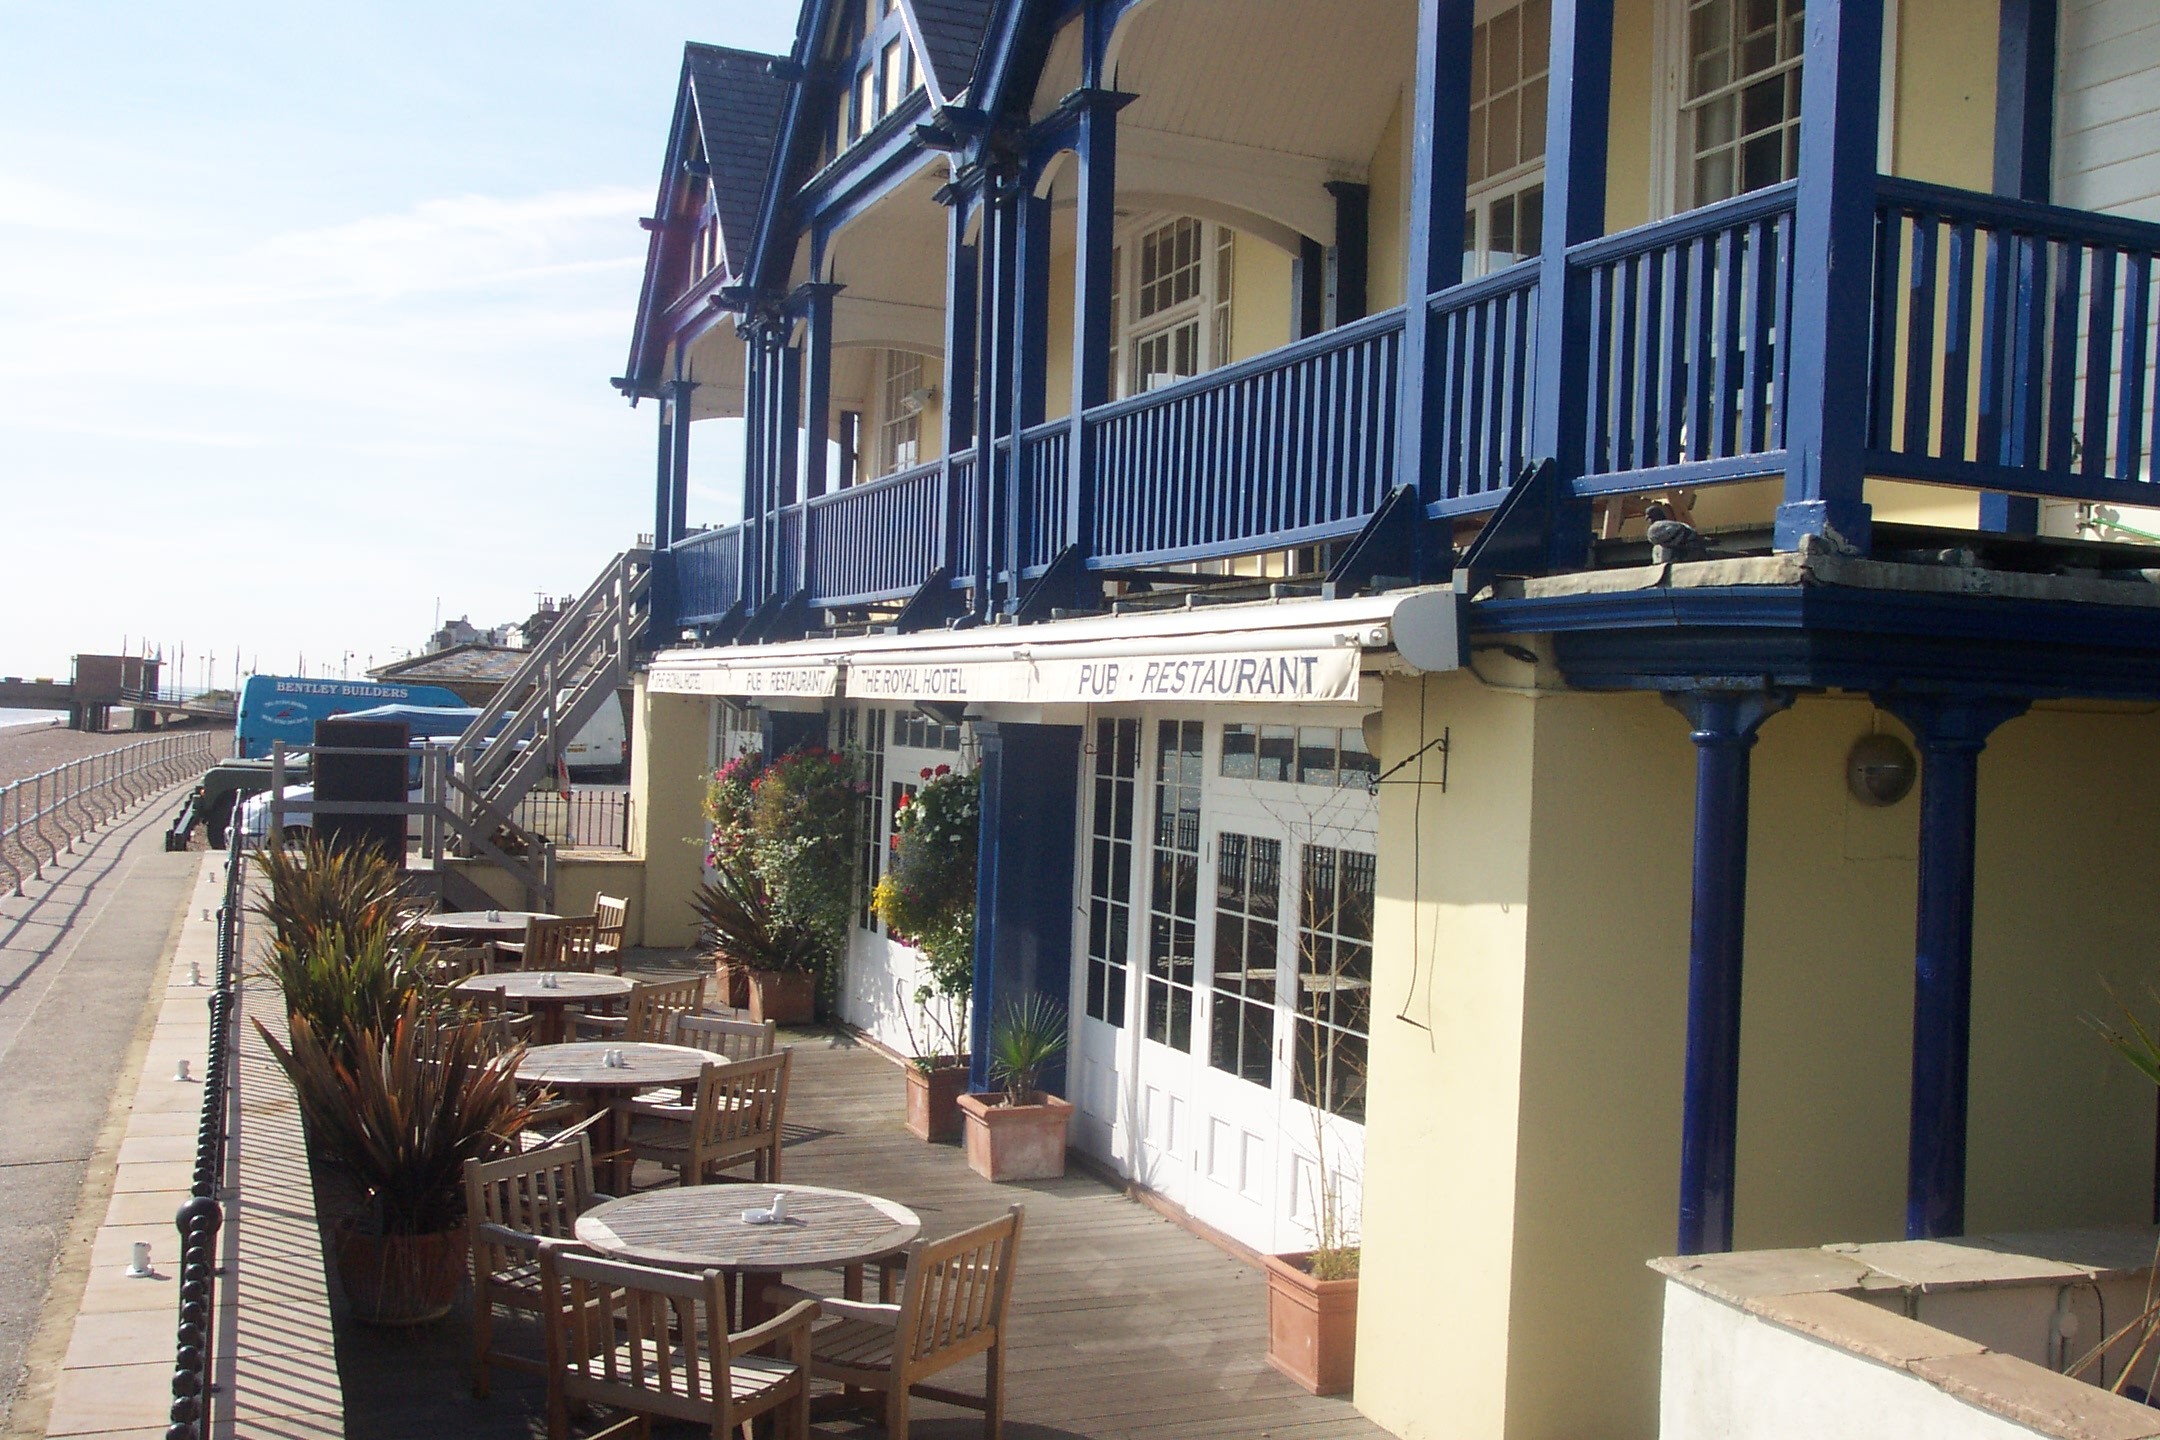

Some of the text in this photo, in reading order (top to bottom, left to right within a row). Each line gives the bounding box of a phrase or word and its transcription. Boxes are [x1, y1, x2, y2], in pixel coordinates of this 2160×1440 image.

[746, 671, 827, 691] PUB RESTAURANT
[862, 668, 967, 694] THE ROYAL HOTEL
[1078, 656, 1318, 695] PUB RESTAURANT
[276, 682, 409, 699] BENTLEY BUILDERS
